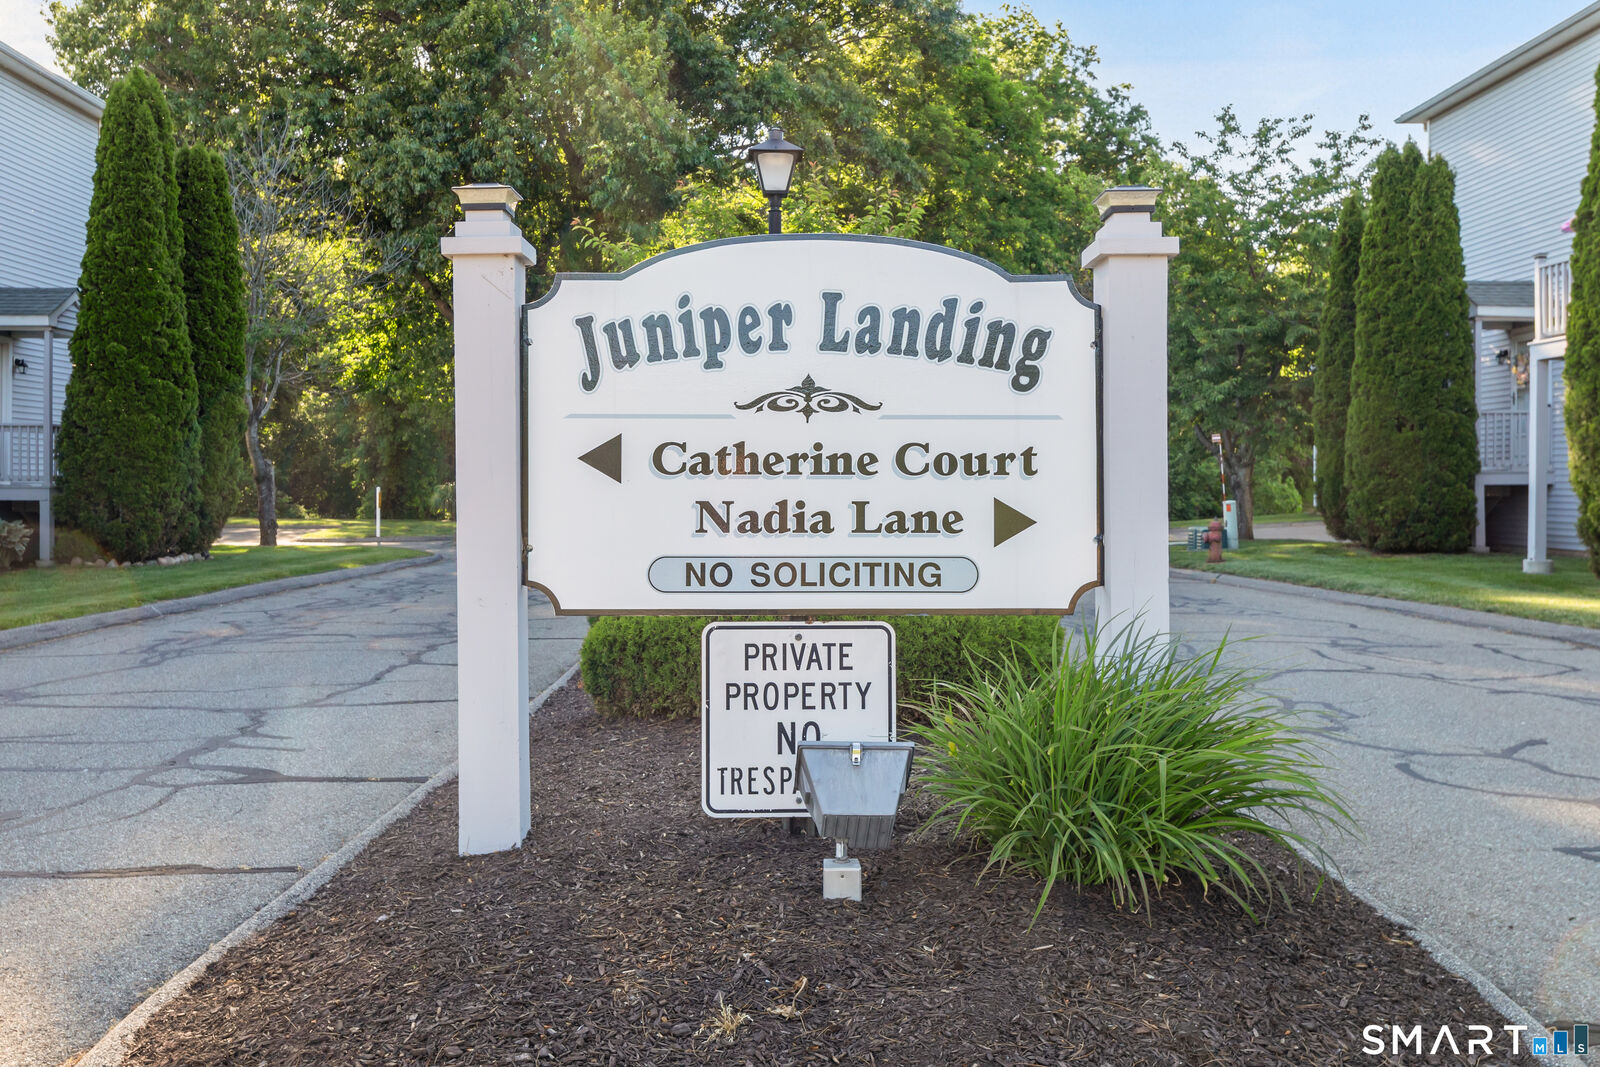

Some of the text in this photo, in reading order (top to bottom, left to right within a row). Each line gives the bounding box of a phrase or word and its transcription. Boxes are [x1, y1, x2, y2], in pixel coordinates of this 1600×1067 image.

[575, 290, 1052, 393] Juniper Landing
[650, 441, 1039, 477] Catherine Court
[693, 499, 965, 536] Nadia Lane
[685, 561, 942, 588] NO SOLICITING
[744, 643, 854, 671] PRIVATE
[725, 682, 872, 711] PROPERTY
[777, 721, 821, 755] NO
[717, 766, 799, 796] TRESP
